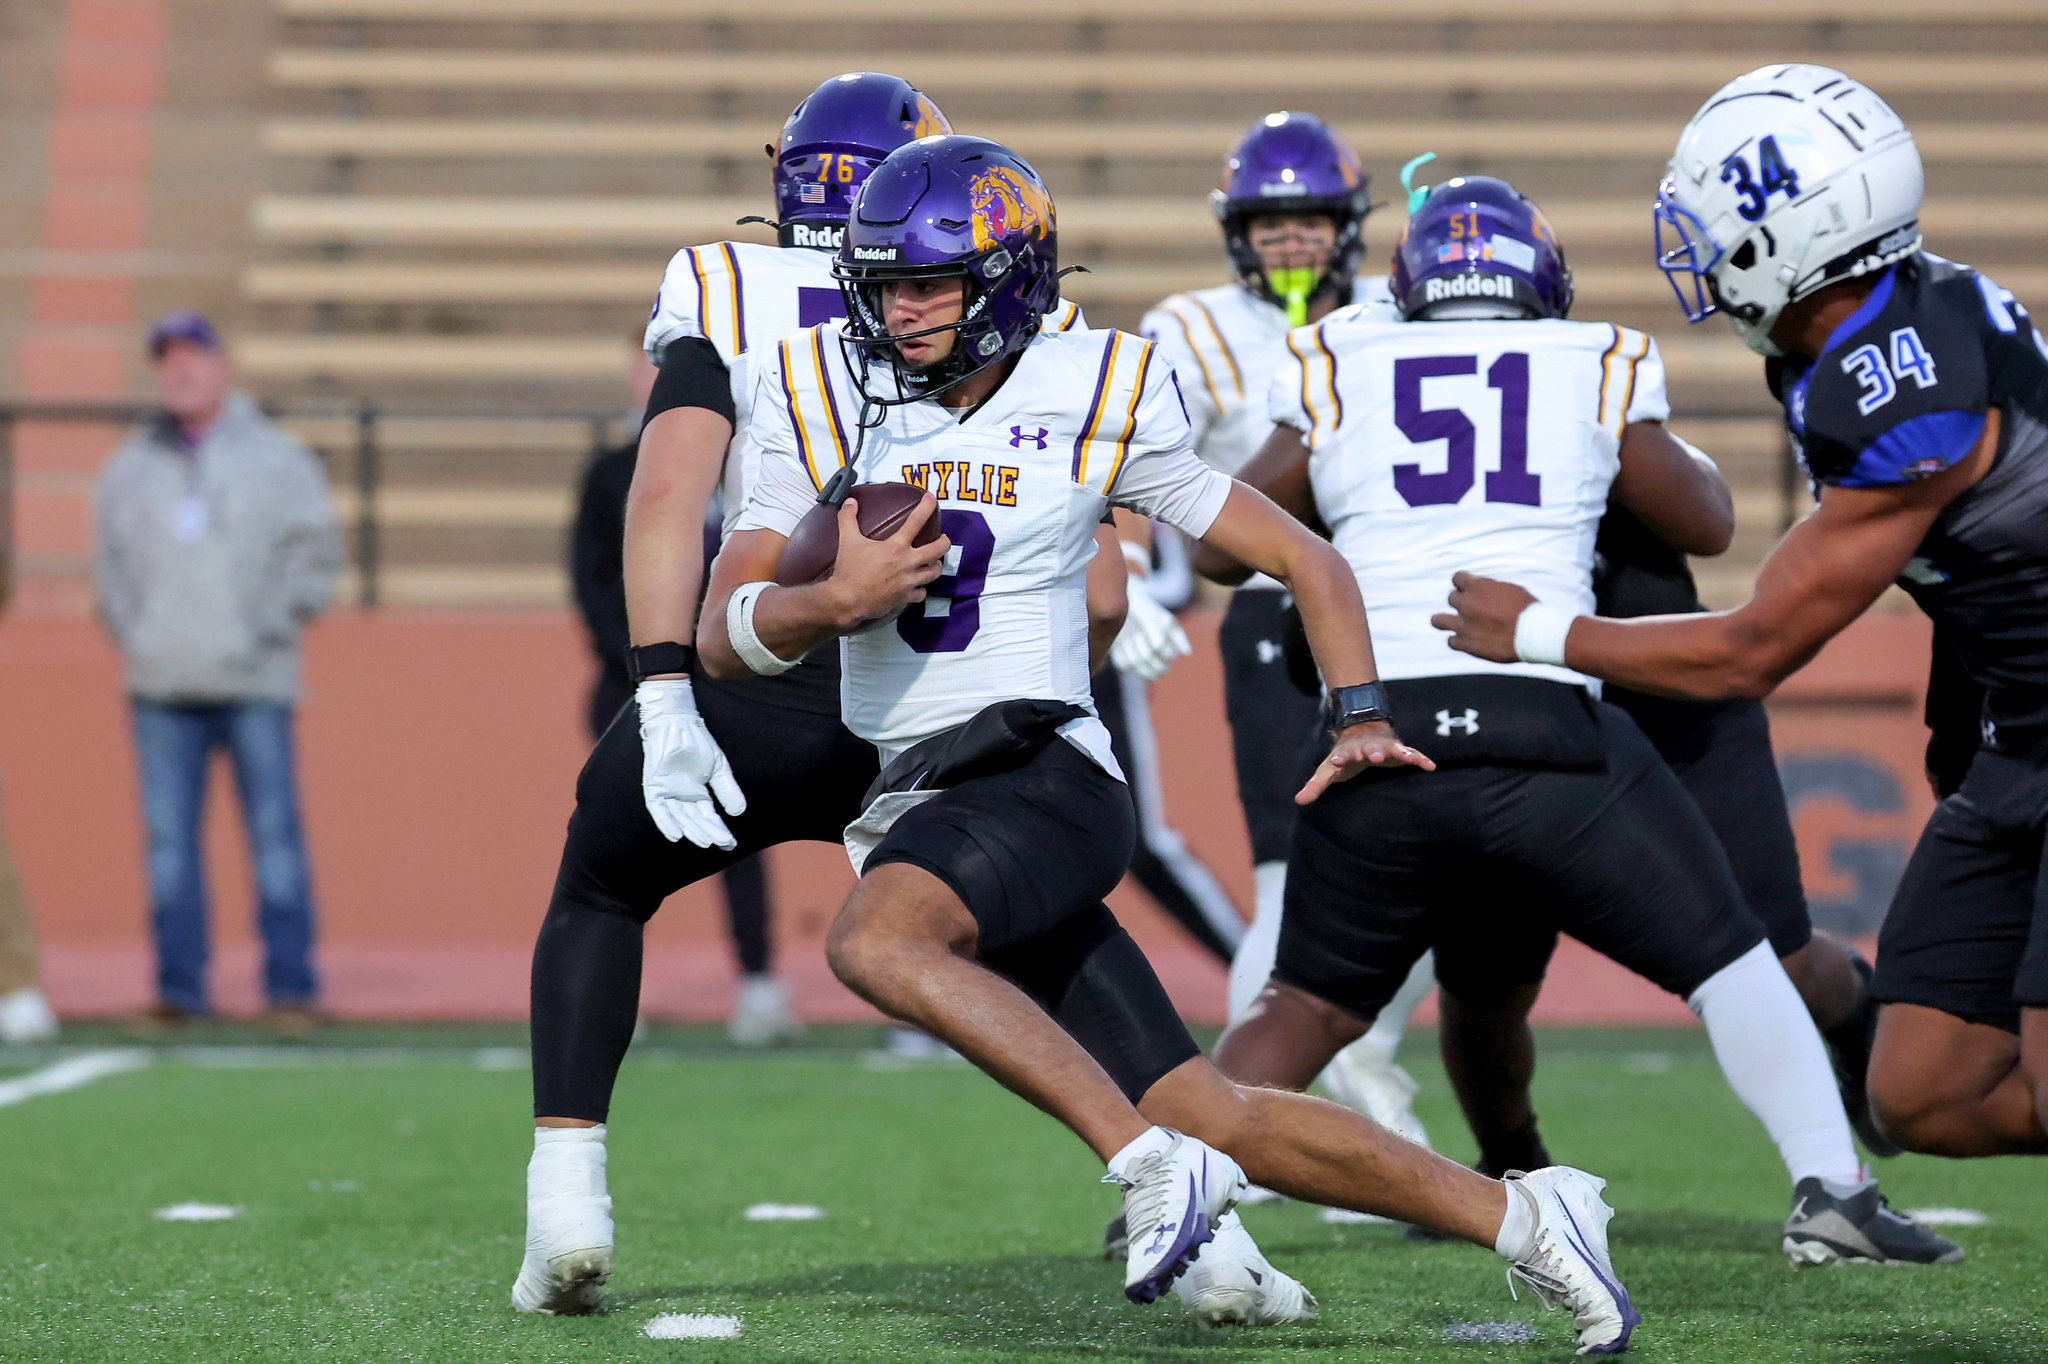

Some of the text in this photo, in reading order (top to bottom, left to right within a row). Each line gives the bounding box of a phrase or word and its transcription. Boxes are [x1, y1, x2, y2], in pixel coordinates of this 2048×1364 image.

[818, 153, 854, 183] 76
[1720, 134, 1800, 222] 34
[1449, 213, 1479, 238] 51
[854, 247, 897, 260] Riddell
[1426, 273, 1514, 302] Riddell
[1840, 326, 1938, 417] 34
[1392, 351, 1541, 508] 51
[902, 461, 1020, 507] WYLIE
